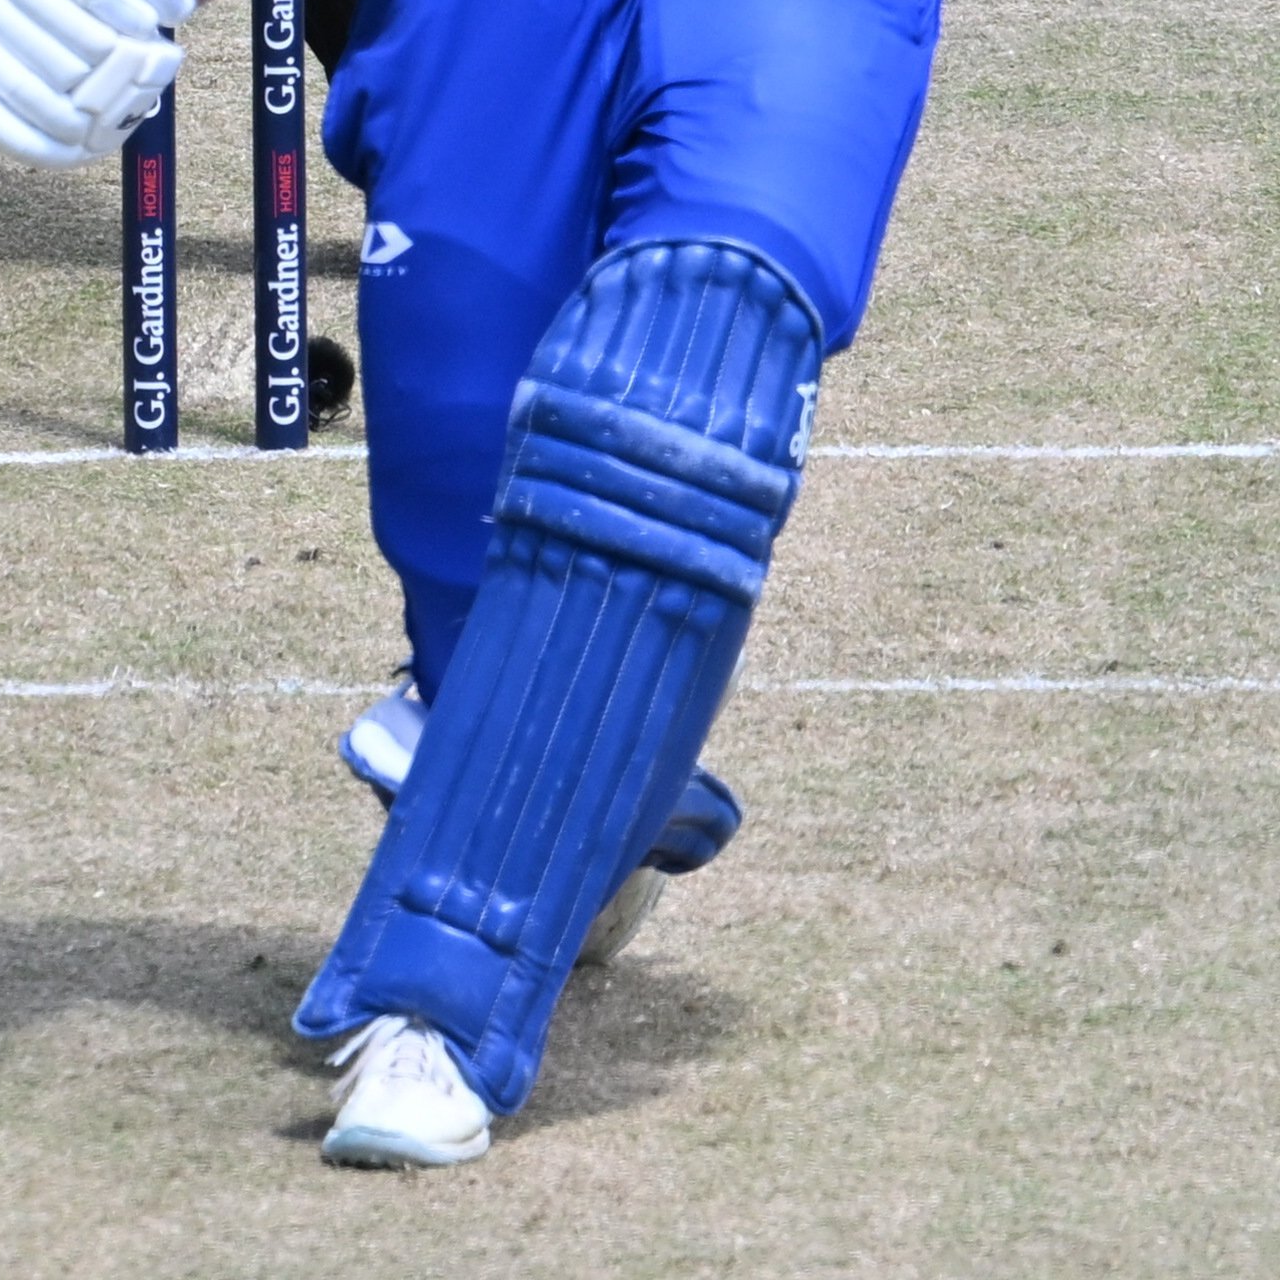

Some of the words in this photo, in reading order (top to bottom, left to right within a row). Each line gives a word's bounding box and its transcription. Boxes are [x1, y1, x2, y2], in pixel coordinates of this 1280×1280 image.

[264, 56, 301, 115] G.J.
[145, 158, 157, 216] HOMES
[279, 153, 292, 212] HOMES
[132, 227, 163, 365] Gardner.
[268, 223, 299, 360] Gardner.
[133, 371, 170, 429] G.J.
[269, 366, 305, 425] G.J.
